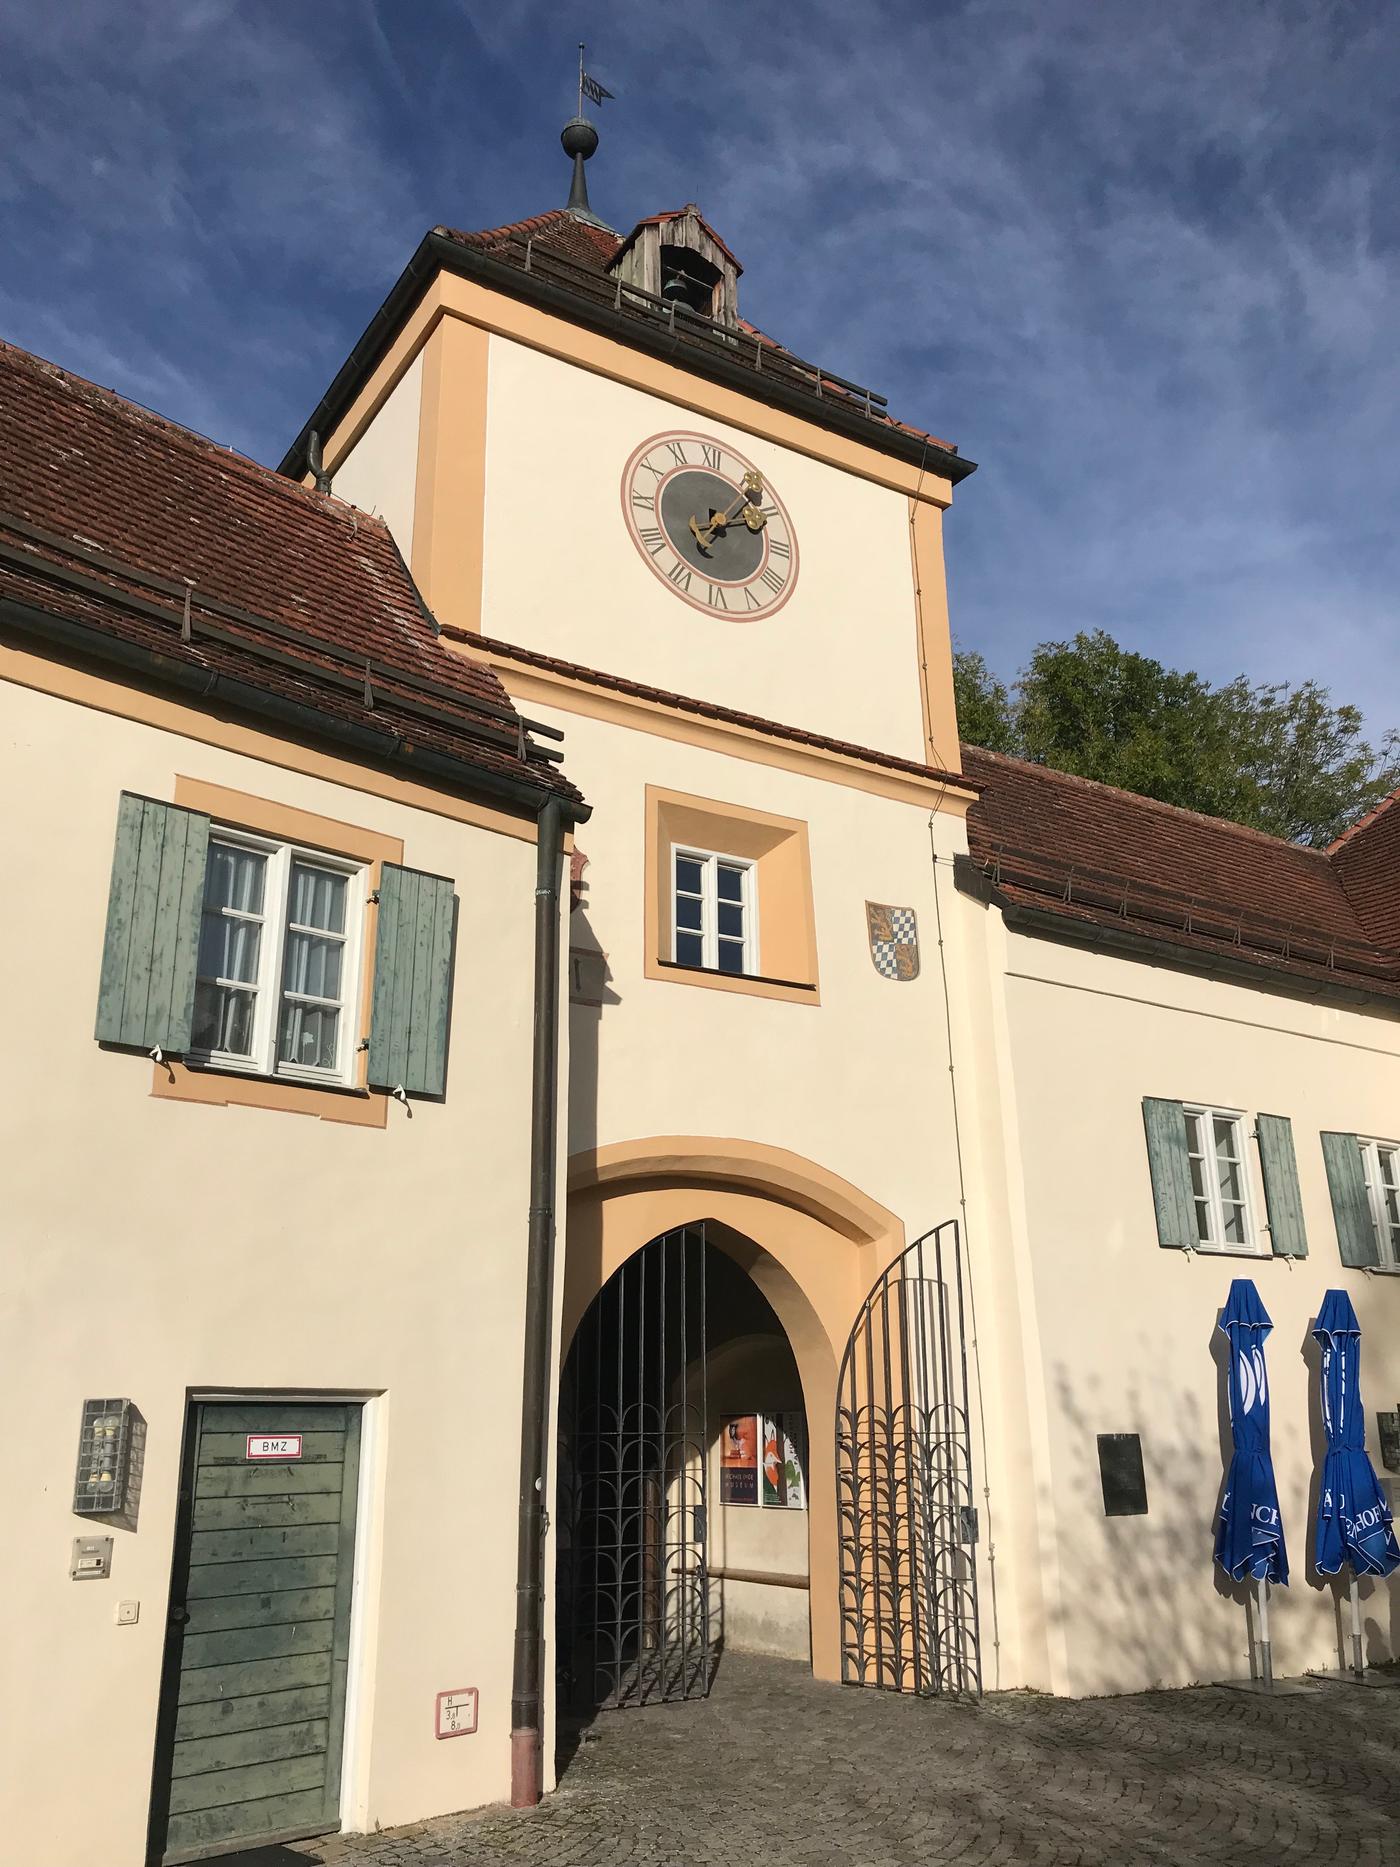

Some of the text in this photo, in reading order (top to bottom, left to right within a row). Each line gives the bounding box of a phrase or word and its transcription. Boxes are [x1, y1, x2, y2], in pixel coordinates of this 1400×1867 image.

[666, 442, 689, 466] XI
[701, 445, 721, 471] XII
[641, 457, 665, 482] X
[632, 489, 655, 511] IX
[639, 527, 667, 556] VIII
[769, 539, 790, 559] III
[668, 562, 692, 592] VII
[760, 567, 785, 594] IIII
[708, 584, 728, 610] VI
[744, 587, 761, 610] V
[262, 1441, 288, 1452] BMZ
[447, 1696, 453, 1706] H
